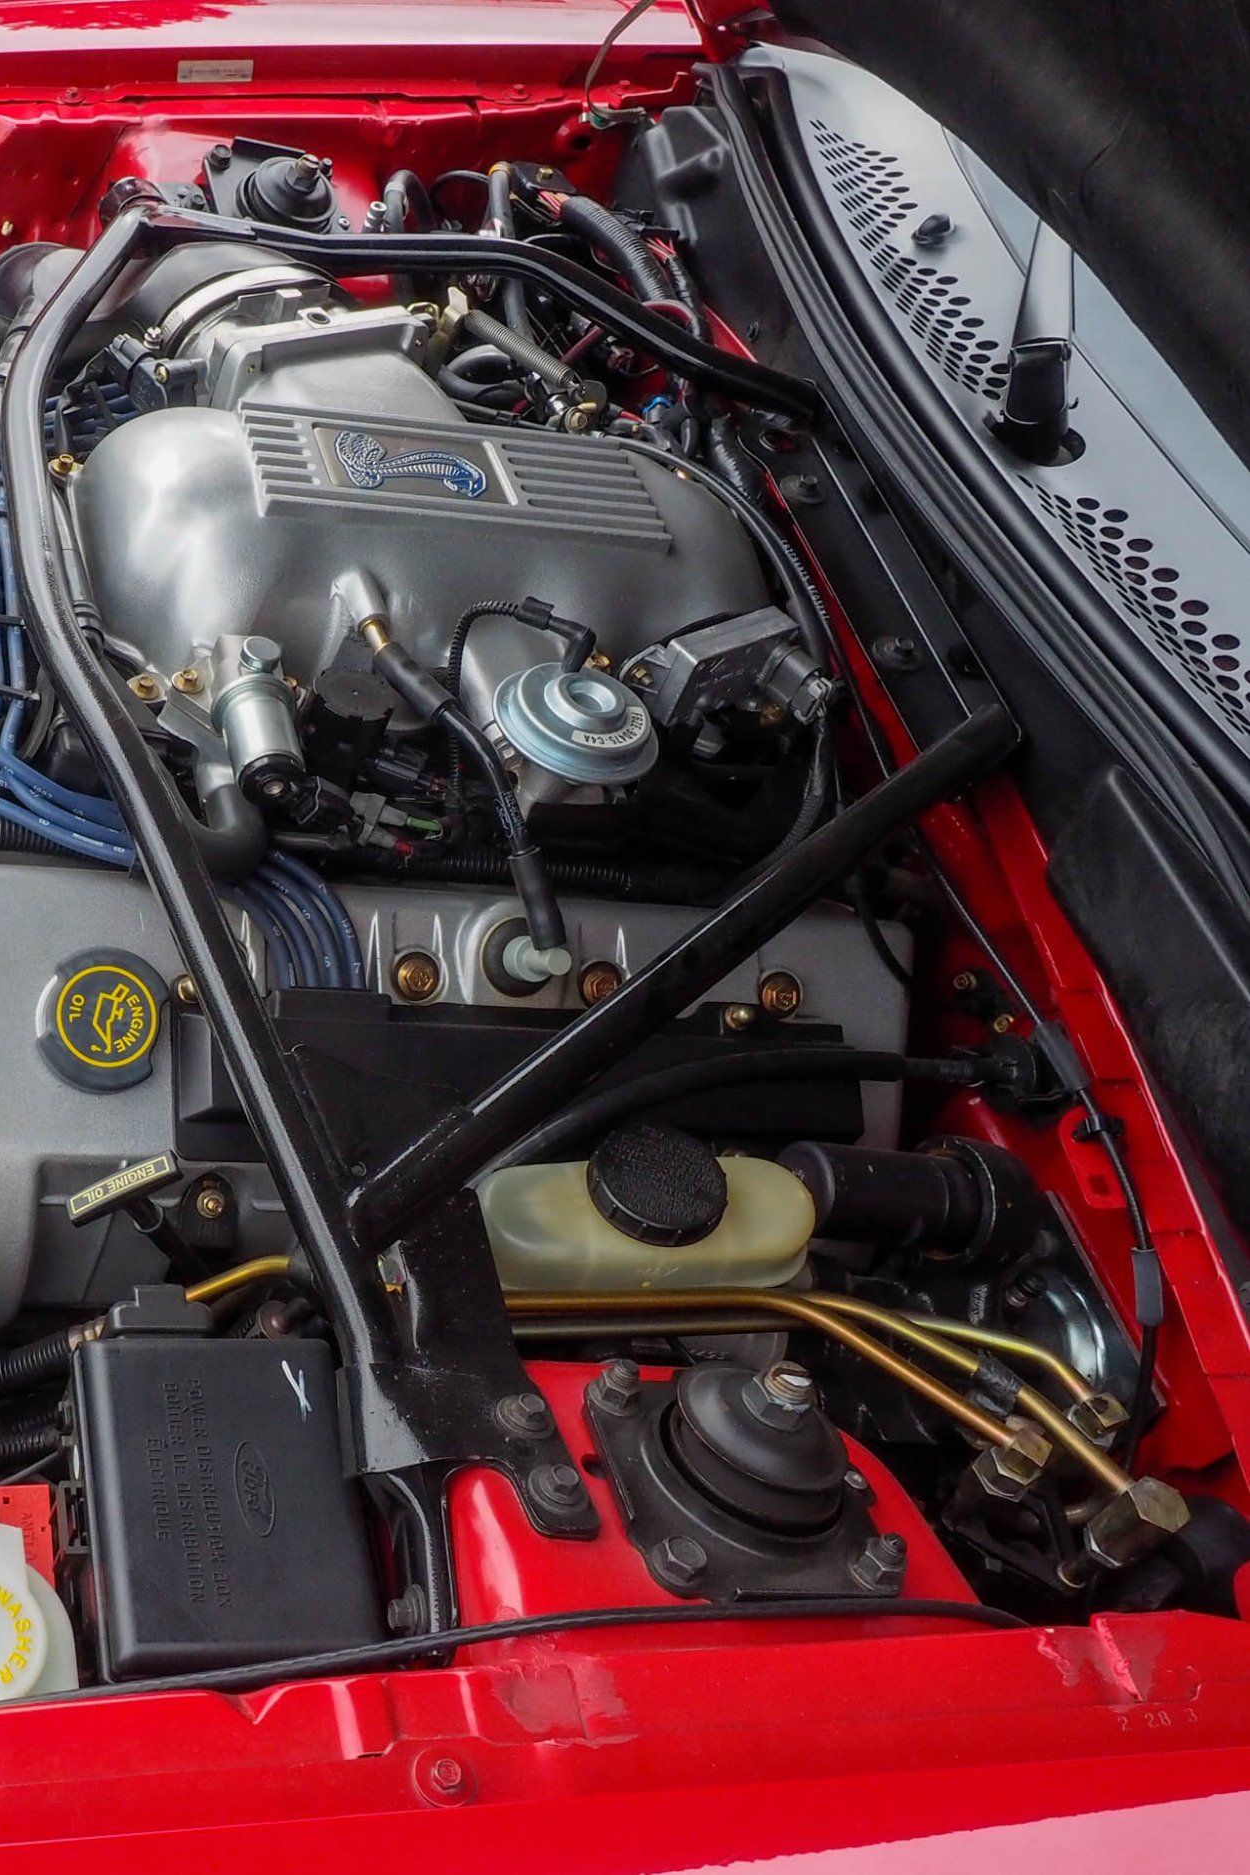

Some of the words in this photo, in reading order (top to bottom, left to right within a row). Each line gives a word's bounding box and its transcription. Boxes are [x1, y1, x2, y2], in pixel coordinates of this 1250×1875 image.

[68, 993, 85, 1023] OIL
[113, 994, 145, 1053] ENGINE
[82, 1187, 104, 1203] OIL
[106, 1163, 155, 1192] ENGINE
[187, 1378, 209, 1439] POWER
[172, 1453, 189, 1474] DE
[195, 1446, 226, 1564] DISTRIBUTION
[175, 1483, 206, 1604] DISTRIBUTION
[213, 1571, 232, 1609] BOX
